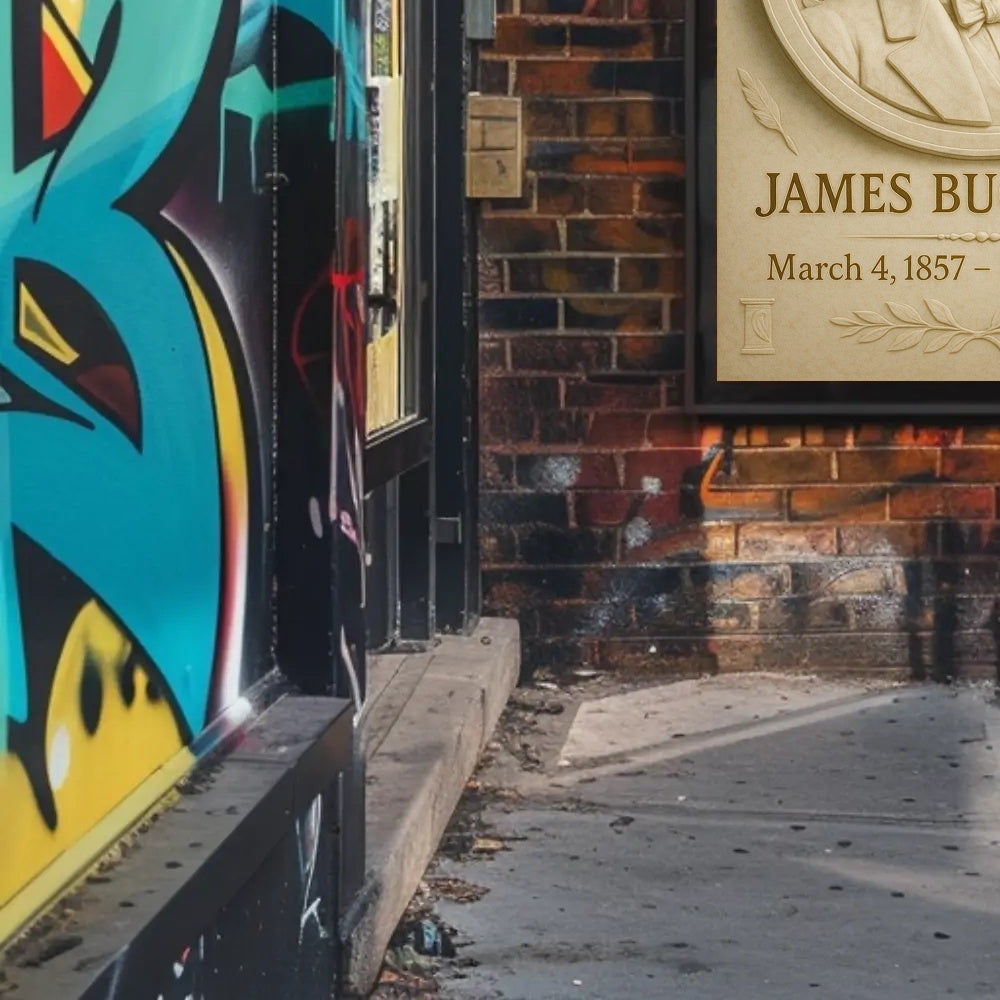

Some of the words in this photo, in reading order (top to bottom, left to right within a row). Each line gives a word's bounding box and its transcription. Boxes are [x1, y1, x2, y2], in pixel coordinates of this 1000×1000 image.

[755, 172, 913, 217] JAMES
[767, 253, 863, 281] March
[871, 254, 897, 285] 4,
[904, 254, 966, 281] 1857
